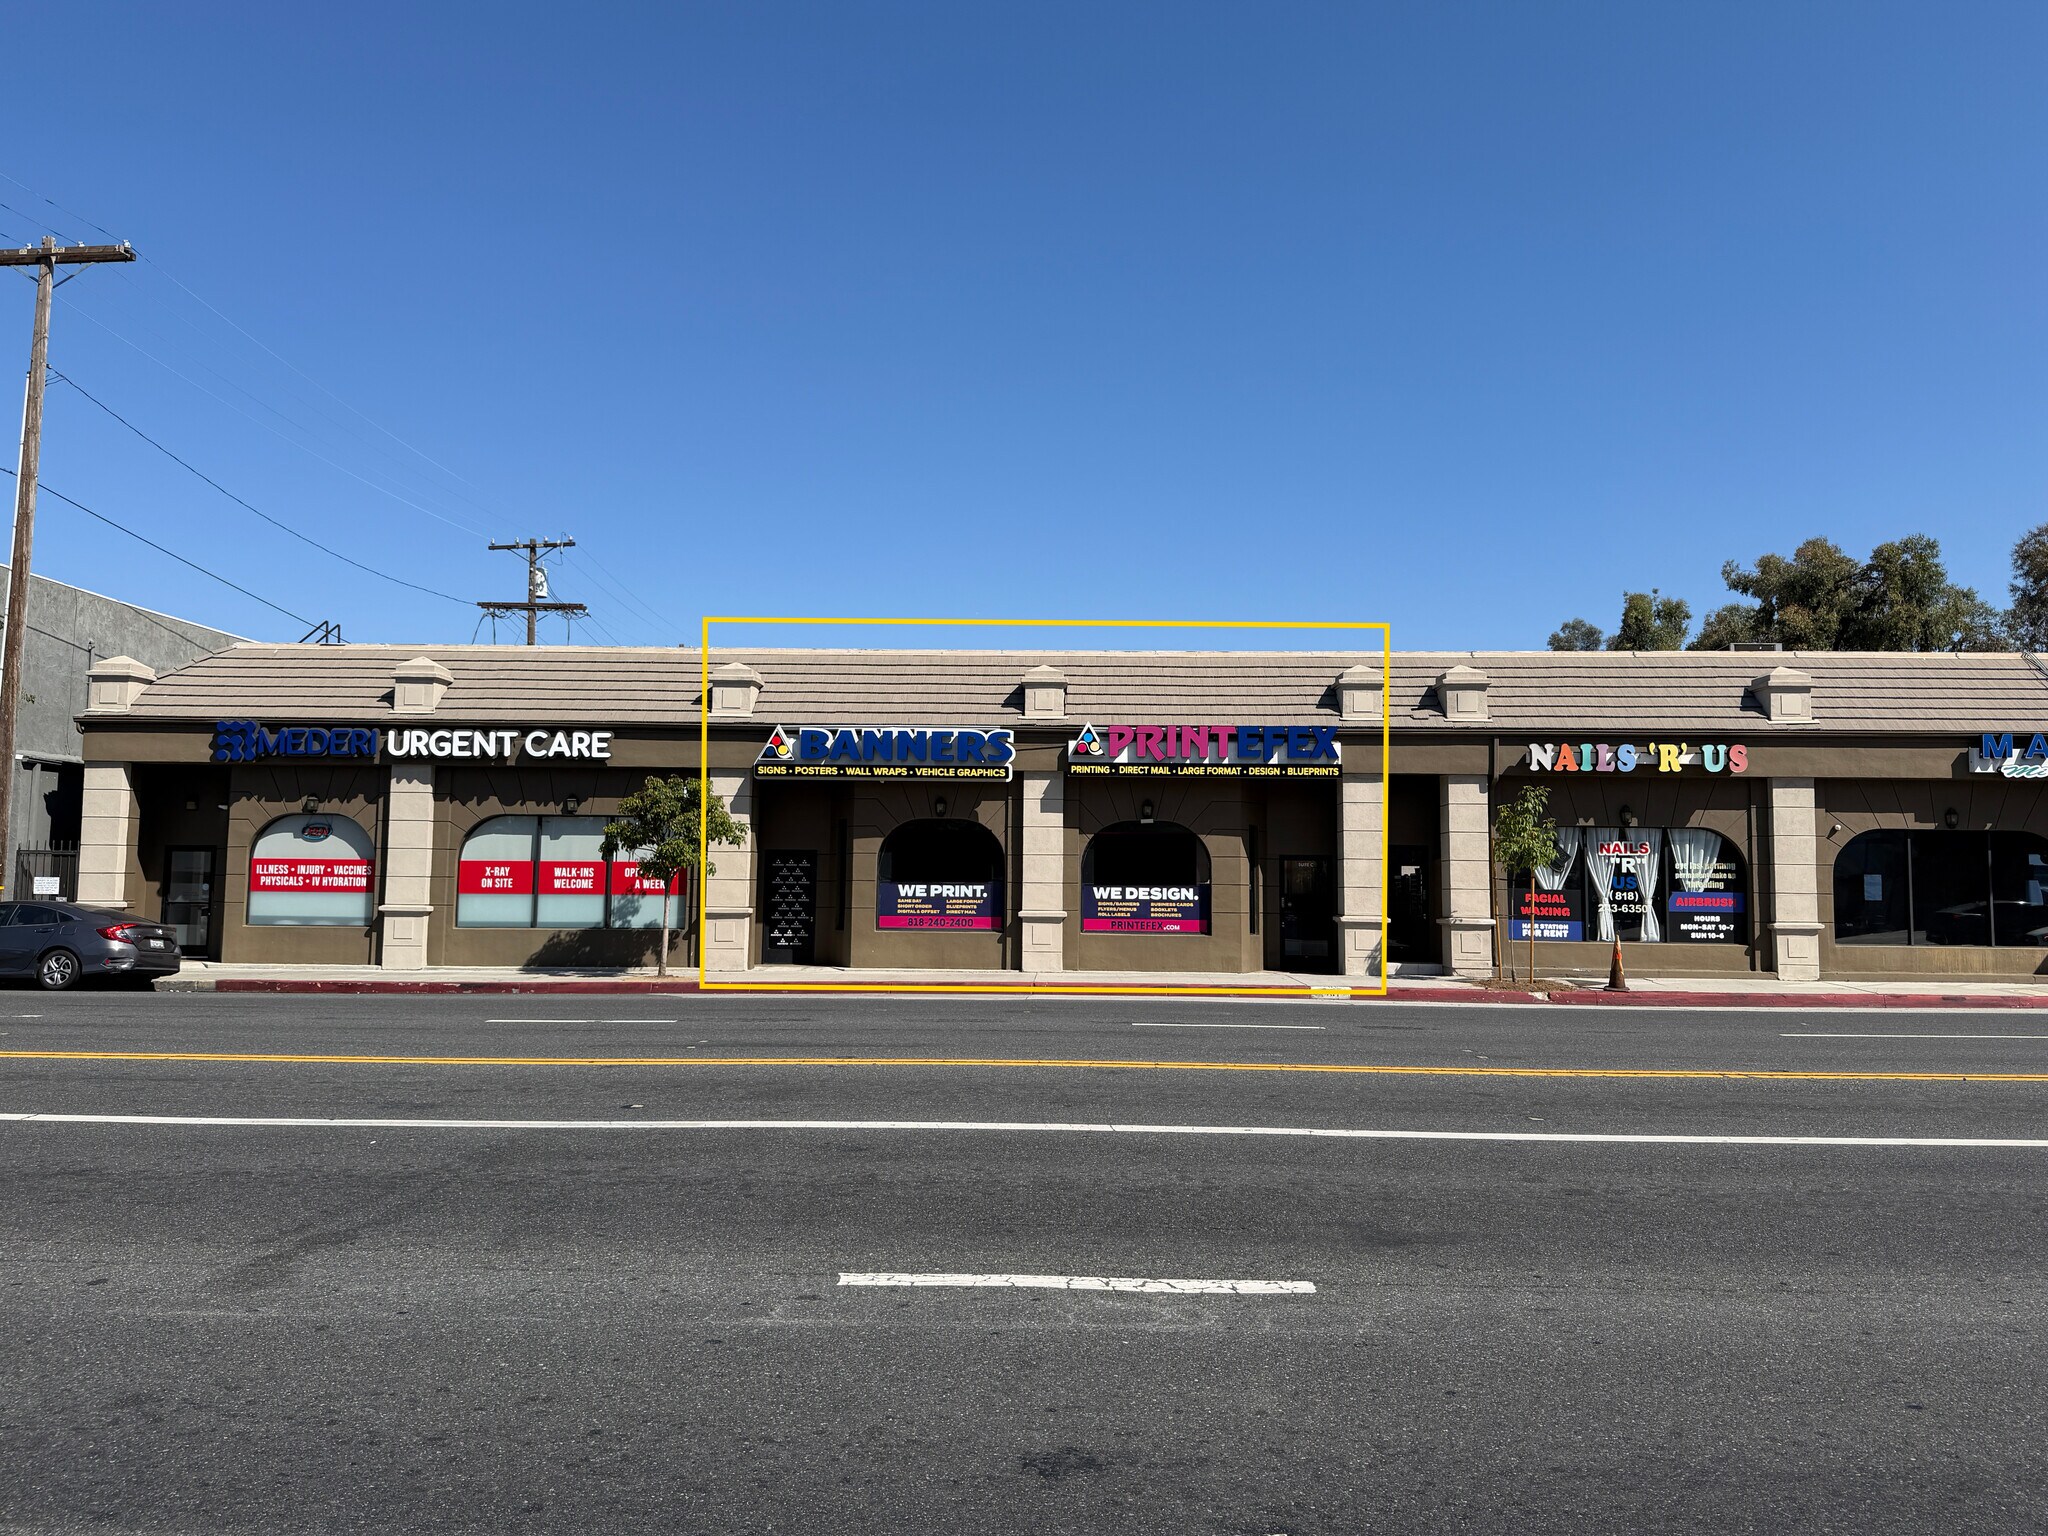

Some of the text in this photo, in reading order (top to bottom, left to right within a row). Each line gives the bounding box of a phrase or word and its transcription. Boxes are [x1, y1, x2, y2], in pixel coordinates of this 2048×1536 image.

[256, 728, 378, 756] MEDERI
[387, 729, 613, 759] URGENT CARE
[800, 729, 1013, 762] BANNERS
[1108, 725, 1339, 762] PRINTEFEX
[1529, 742, 1749, 773] NAILS 'R' US
[757, 766, 1006, 778] SIGNS POSTERS WALL WRAPS VEHICLE GRAPHICS
[1071, 765, 1339, 777] PRINTING DIRECT MAIL LARGE FORMAT DESIGN BLUEPRINTS
[1599, 841, 1650, 855] NAILS
[256, 864, 372, 875] ILLNESS INJURY VACCINES
[485, 866, 510, 877] X-RAY
[554, 867, 594, 877] WALK-INS
[260, 876, 367, 887] PHYSICALS IV HYDRATION
[481, 878, 513, 888] ON SITE
[554, 878, 593, 889] WELCOME
[634, 879, 666, 889] A WEEK
[1612, 876, 1637, 889] US
[898, 884, 988, 898] WE PRINT.
[1093, 887, 1199, 901] WE DESIGN.
[1609, 890, 1639, 902] (818)
[1525, 893, 1566, 904] FACIAL
[1520, 906, 1571, 917] WAXING
[908, 918, 973, 927] 818-240-2400
[1543, 930, 1569, 938] RENT
